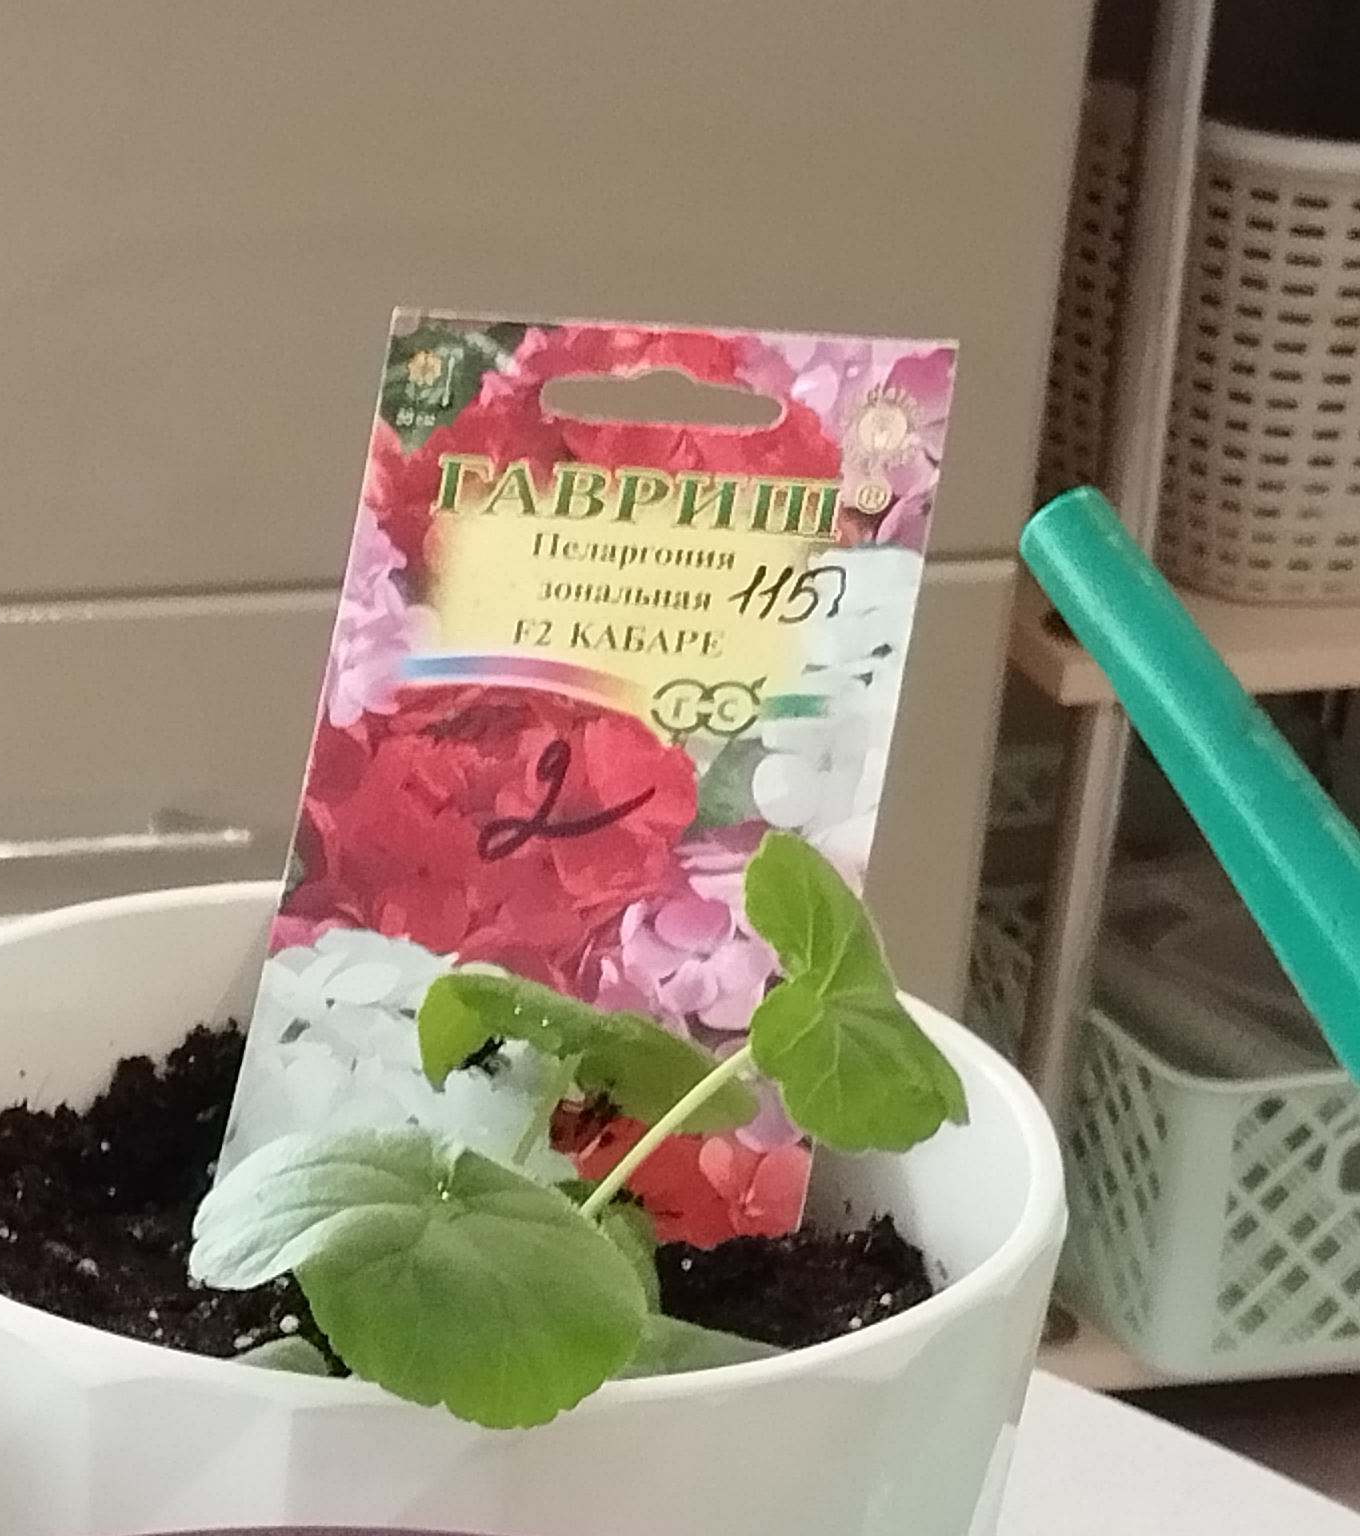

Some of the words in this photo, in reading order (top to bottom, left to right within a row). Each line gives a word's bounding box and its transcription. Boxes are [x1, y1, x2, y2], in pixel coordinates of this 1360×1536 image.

[430, 454, 843, 542] ГАВРИШ
[532, 532, 737, 571] Пеларгония
[537, 580, 713, 612] зональная
[512, 618, 553, 646] F2
[569, 620, 726, 658] КАБАРЕ
